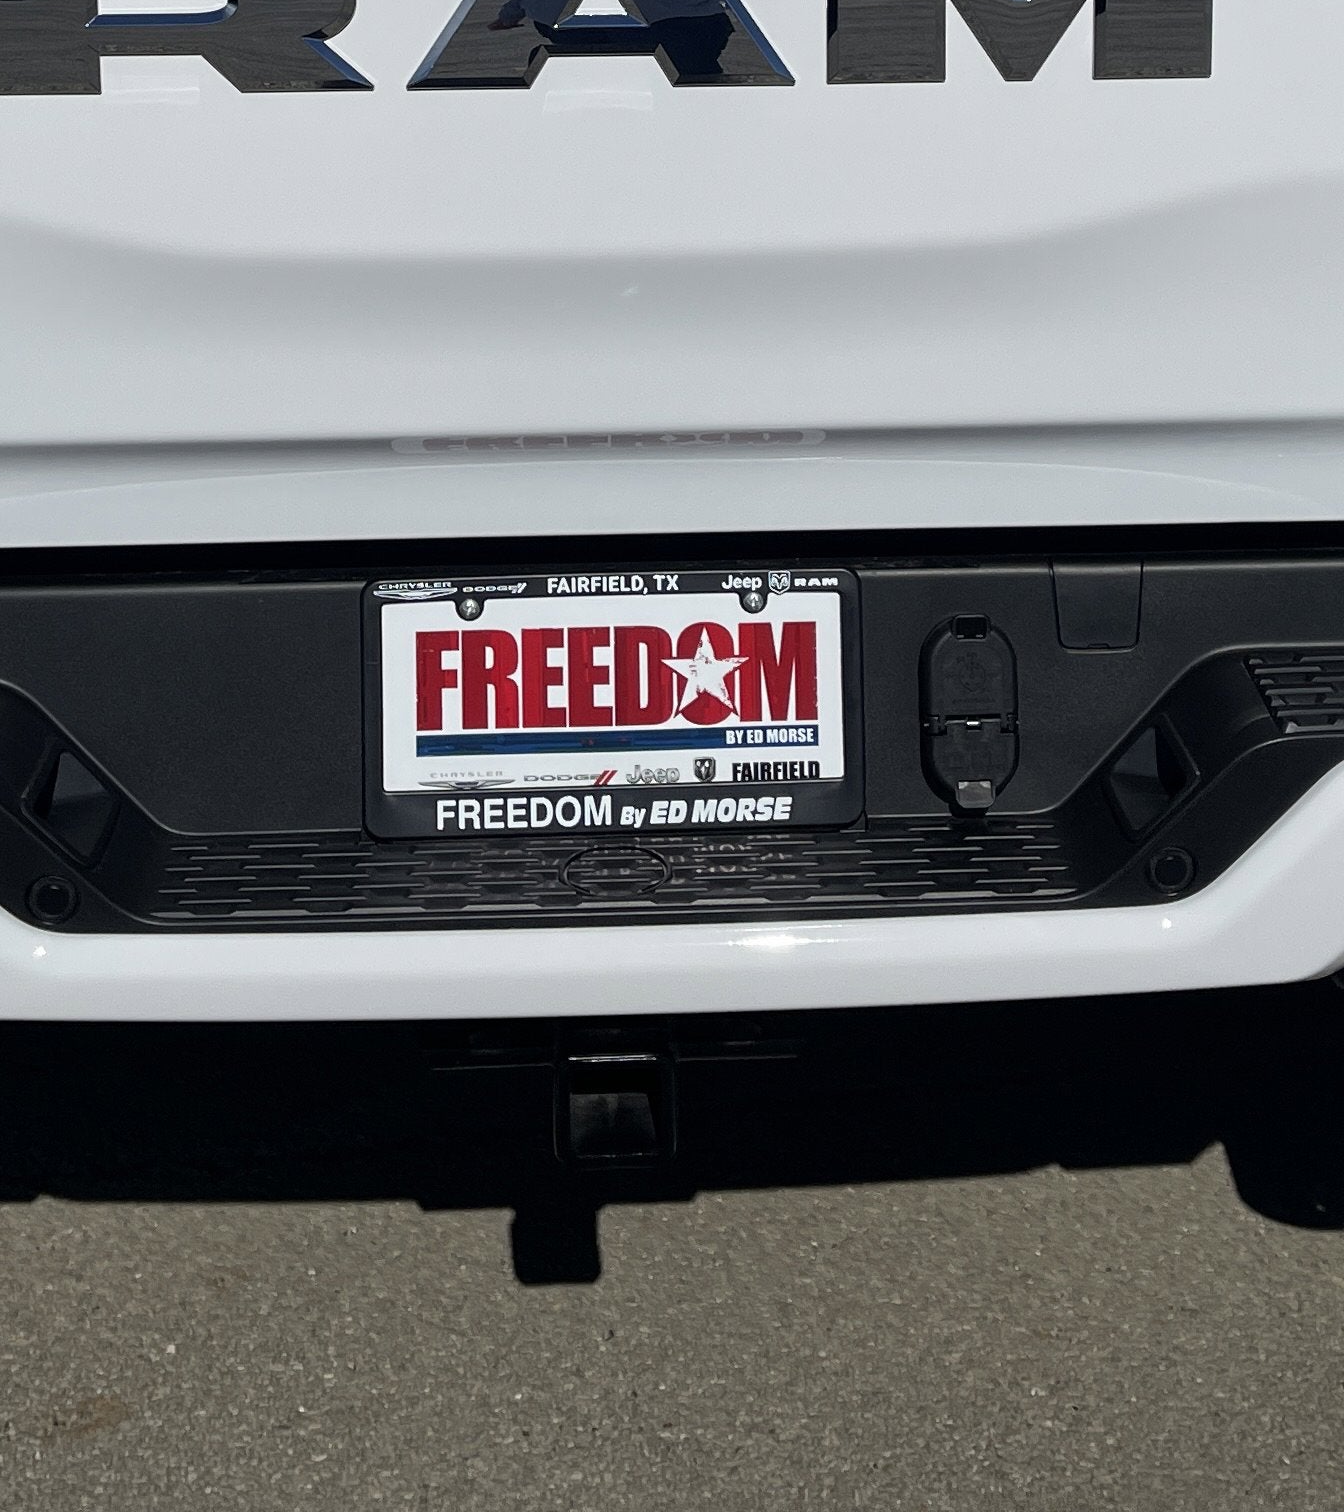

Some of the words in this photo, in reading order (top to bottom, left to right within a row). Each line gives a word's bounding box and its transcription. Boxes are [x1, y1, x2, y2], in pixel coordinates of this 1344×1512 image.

[378, 581, 452, 590] CHRYSLER
[462, 584, 518, 593] DODGE
[547, 575, 648, 595] FAIRFIELD,
[652, 575, 680, 592] TX
[721, 574, 762, 591] Jeep
[793, 577, 839, 587] RAM
[415, 621, 820, 731] FREEDOM
[726, 729, 745, 745] BY
[746, 729, 763, 744] ED
[766, 727, 814, 744] MORSE
[429, 770, 504, 779] CHRYSLER
[523, 773, 598, 783] DODGE
[626, 764, 681, 785] Jeep
[731, 760, 821, 783] FAIRFIELD
[435, 795, 613, 831] FREEDOM
[620, 805, 647, 829] By
[650, 800, 688, 825] ED
[691, 796, 794, 824] MORSE
